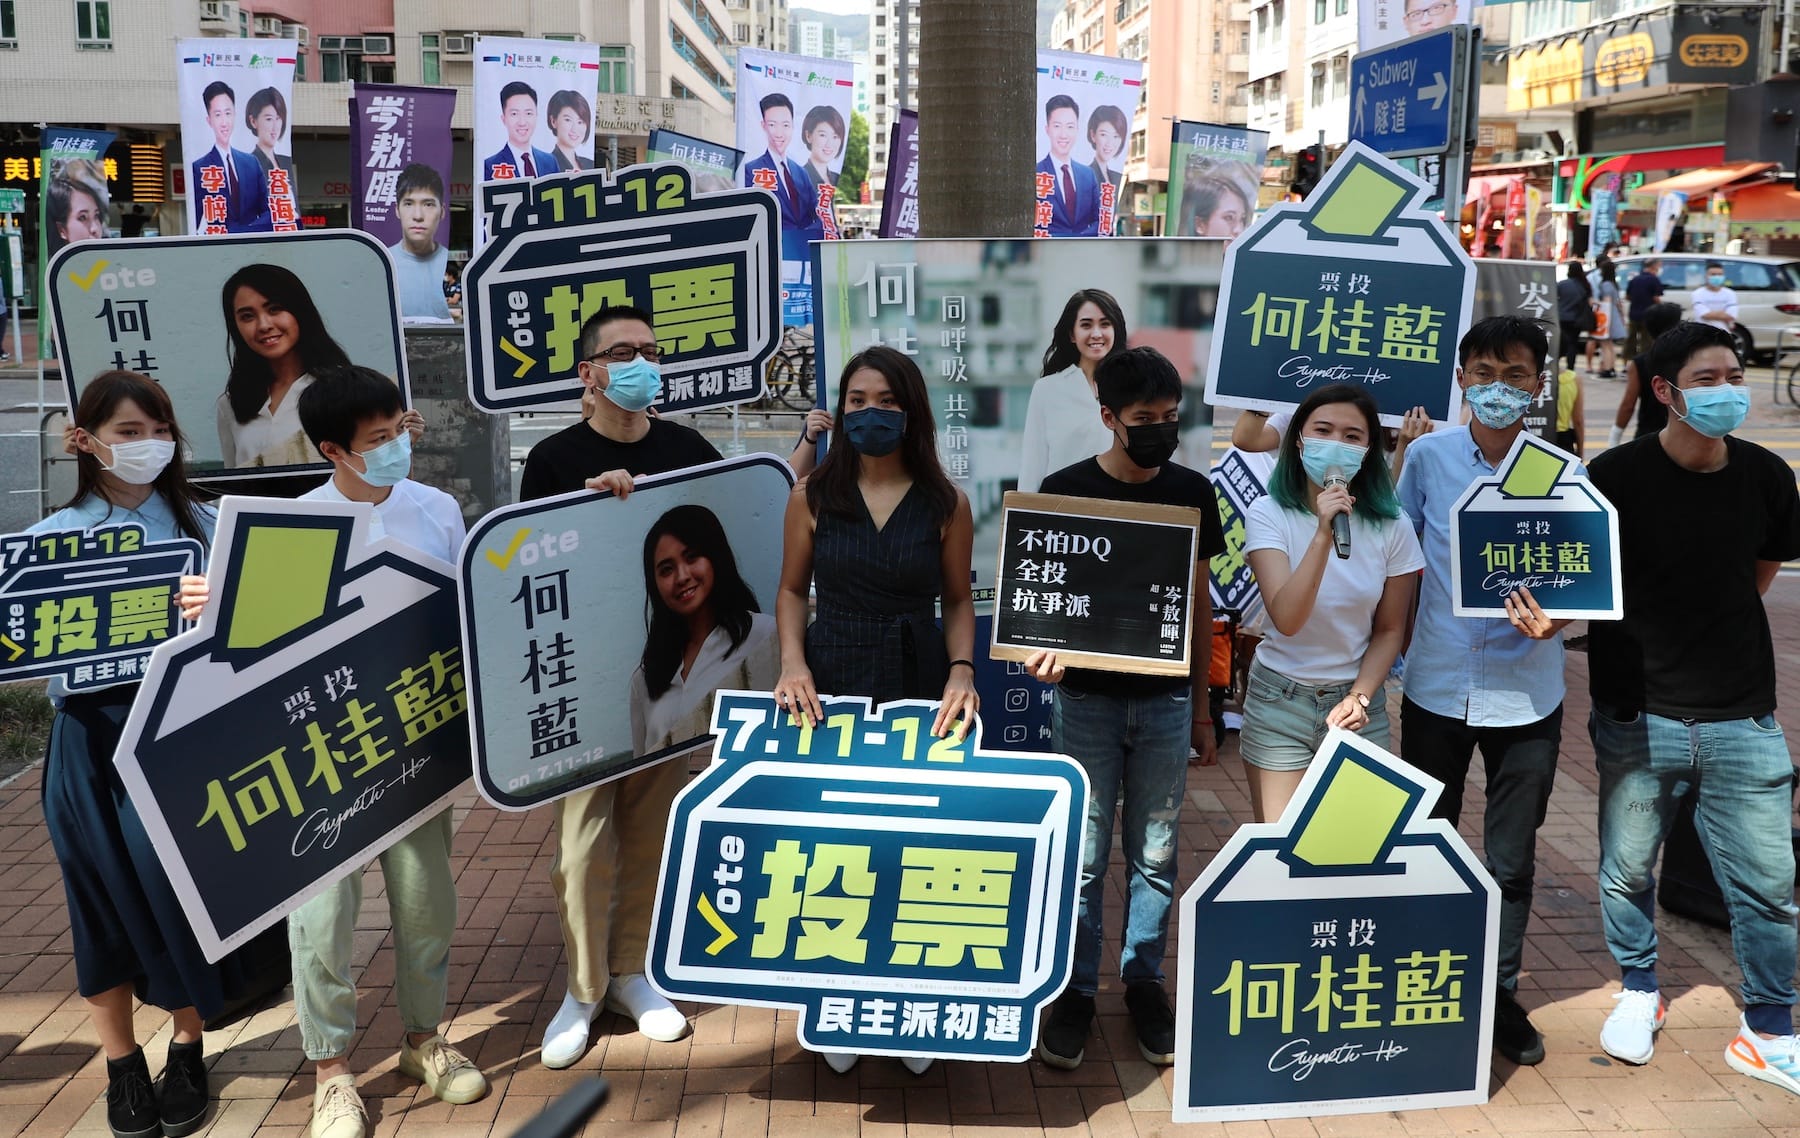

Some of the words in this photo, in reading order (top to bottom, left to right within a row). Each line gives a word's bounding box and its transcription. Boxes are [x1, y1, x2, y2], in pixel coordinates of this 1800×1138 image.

[1369, 58, 1417, 88] Subway
[1374, 96, 1406, 136] 隧道
[51, 137, 98, 153] 何桂藍
[668, 142, 727, 168] 何桂藍
[1191, 132, 1248, 155] 何桂藍
[492, 174, 686, 229] 7.11-12
[1318, 271, 1371, 295] 票投
[1241, 292, 1446, 364] 何桂藍
[6, 530, 140, 564] 7.11-12
[1017, 528, 1112, 562] 不怕DQ
[1480, 541, 1591, 573] 何桂藍
[1015, 558, 1068, 585] 全投
[34, 585, 171, 658] 投票
[1012, 587, 1091, 618] 抗爭派
[1161, 585, 1183, 641] 岑敖暉
[511, 568, 581, 759] 何桂藍
[283, 665, 359, 726] 票投
[196, 646, 466, 852] 何桂藍
[727, 708, 965, 763] 7.11-12
[508, 772, 530, 791] on
[537, 745, 605, 781] 7.11-12
[751, 840, 1018, 969] 投票
[1310, 918, 1376, 948] 票投
[1211, 949, 1468, 1036] 何桂藍
[816, 996, 1023, 1042] 民主派初選
[1268, 1038, 1362, 1081] Gwyneth
